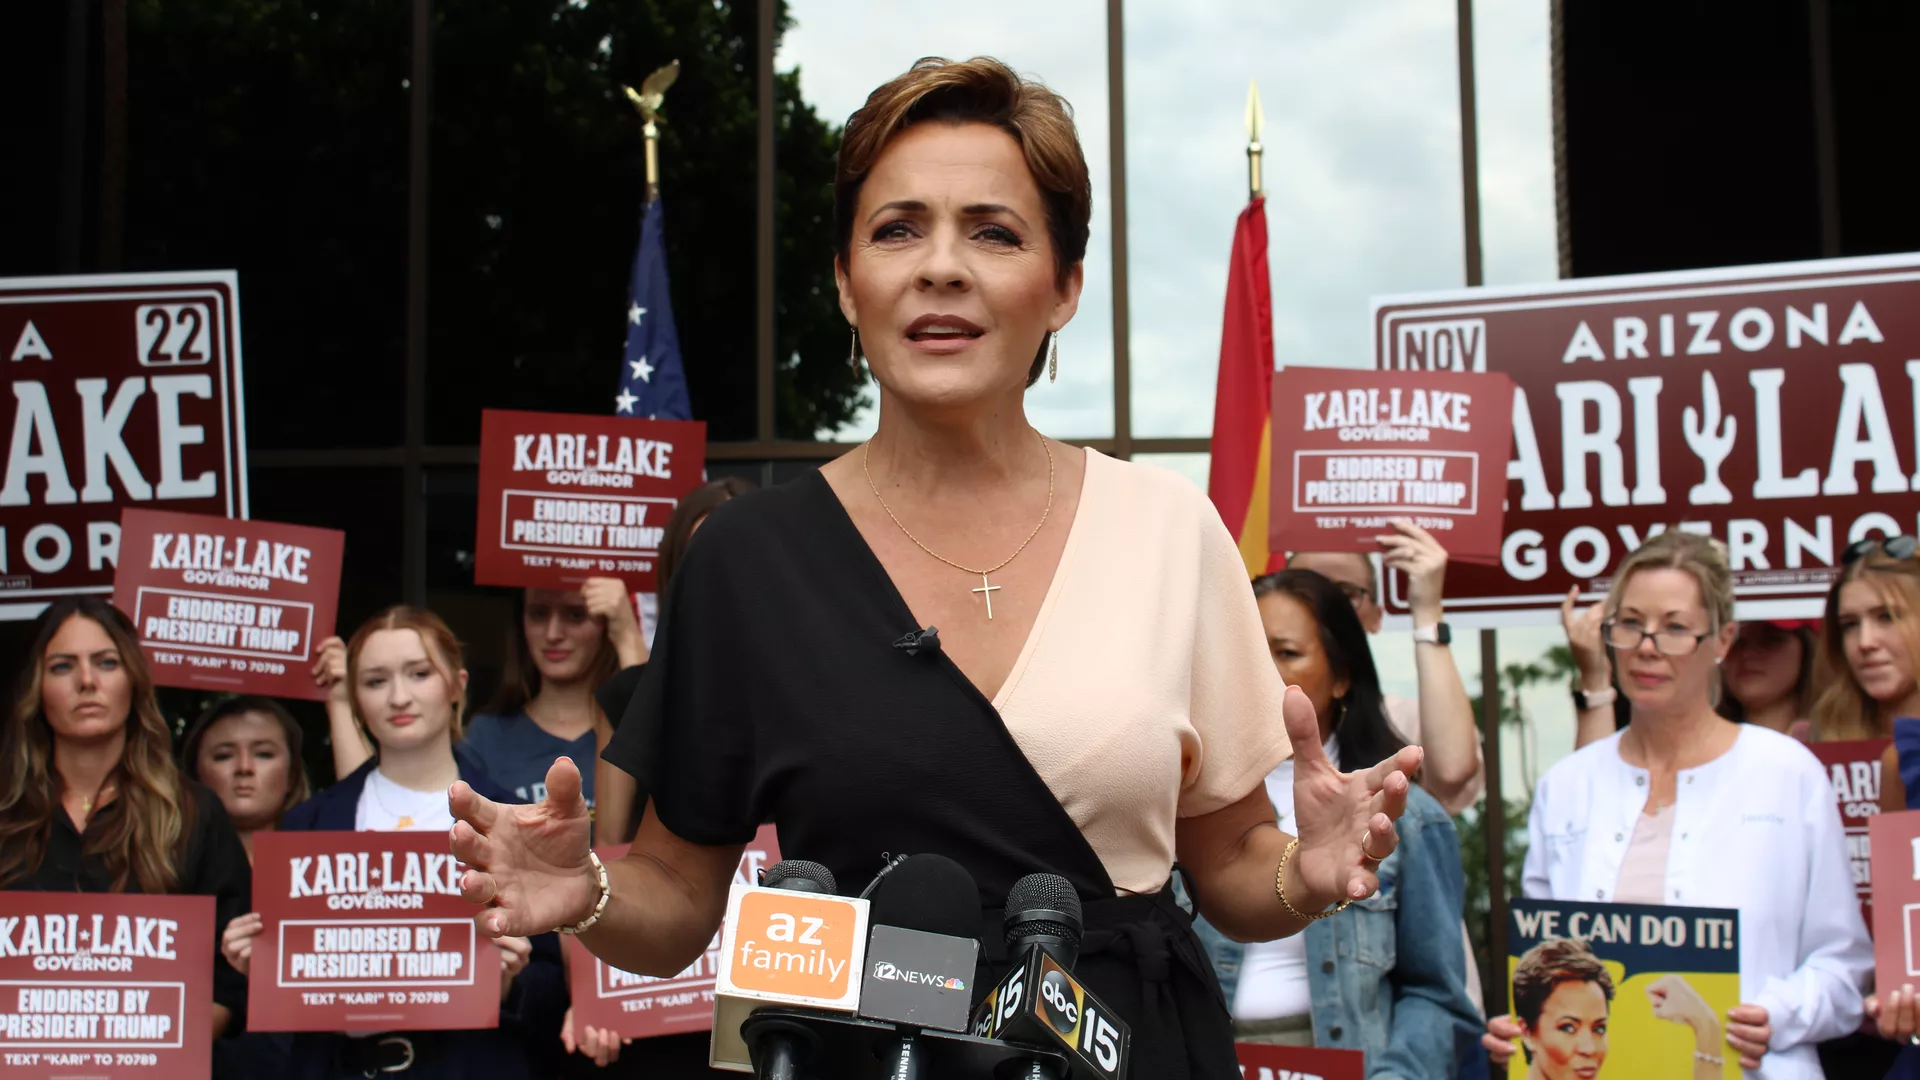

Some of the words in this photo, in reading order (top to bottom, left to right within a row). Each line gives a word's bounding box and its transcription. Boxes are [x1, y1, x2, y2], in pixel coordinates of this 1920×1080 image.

[146, 307, 204, 364] 22
[1562, 300, 1885, 363] ARIZONA
[1405, 326, 1480, 370] NOV
[1304, 388, 1380, 431] KARI
[1390, 388, 1471, 432] LAKE
[0, 374, 216, 506] AKE
[1338, 427, 1430, 441] GOVERNOR
[1505, 376, 1667, 511] ARI
[1749, 359, 1920, 499] LA
[513, 433, 588, 471] KARI
[598, 435, 673, 479] LAKE
[1326, 457, 1419, 481] ENDORSED
[1421, 457, 1446, 481] BY
[547, 470, 633, 488] GOVERNOR
[1305, 480, 1401, 504] PRESIDENT
[1403, 481, 1466, 506] TRUMP
[534, 498, 621, 525] ENDORSED
[624, 504, 647, 526] BY
[1315, 516, 1348, 529] TEXT
[1350, 516, 1388, 529] "KARI
[513, 520, 604, 548] PRESIDENT
[607, 526, 664, 549] TRUMP
[150, 533, 225, 570] KARI
[234, 537, 311, 583] LAKE
[523, 555, 553, 567] TEXT
[599, 559, 615, 571] TO
[183, 570, 270, 590] GOVERNOR
[168, 596, 256, 625] ENDORSED
[259, 606, 282, 628] BY
[145, 616, 238, 646] PRESIDENT
[241, 626, 299, 652] TRUMP
[154, 651, 184, 664] TEXT
[187, 656, 228, 669] "KARI"
[231, 659, 247, 671] TO
[250, 661, 285, 675] 70789
[1830, 760, 1881, 803] ARI
[289, 852, 369, 898] KARI
[381, 851, 466, 896] LAKE
[327, 893, 424, 909] GOVERNOR
[0, 914, 79, 957] KARI
[91, 914, 178, 961] LAKE
[314, 927, 411, 952] ENDORSED
[415, 926, 441, 952] BY
[766, 913, 823, 945] az
[1512, 909, 1560, 941] WE
[1568, 912, 1631, 944] CAN
[1640, 915, 1686, 947] DO
[1695, 918, 1733, 949] IT!
[33, 956, 132, 971] GOVERNOR
[290, 952, 393, 978] PRESIDENT
[396, 952, 462, 977] TRUMP
[741, 941, 845, 982] family
[19, 988, 119, 1014] ENDORSED
[124, 989, 150, 1014] BY
[302, 992, 336, 1005] TEXT
[338, 991, 384, 1005] "KARI"
[388, 992, 407, 1004] TO
[409, 991, 449, 1004] 70789
[621, 997, 653, 1012] TEXT
[656, 991, 699, 1007] "KARI"
[995, 965, 1024, 1031] 15
[104, 1014, 171, 1039] TRUMP
[1042, 981, 1078, 1023] abc
[1083, 1008, 1118, 1072] 15
[4, 1053, 40, 1066] TEXT
[43, 1053, 90, 1066] "KARI"
[94, 1054, 113, 1066] TO
[116, 1054, 157, 1066] 70789
